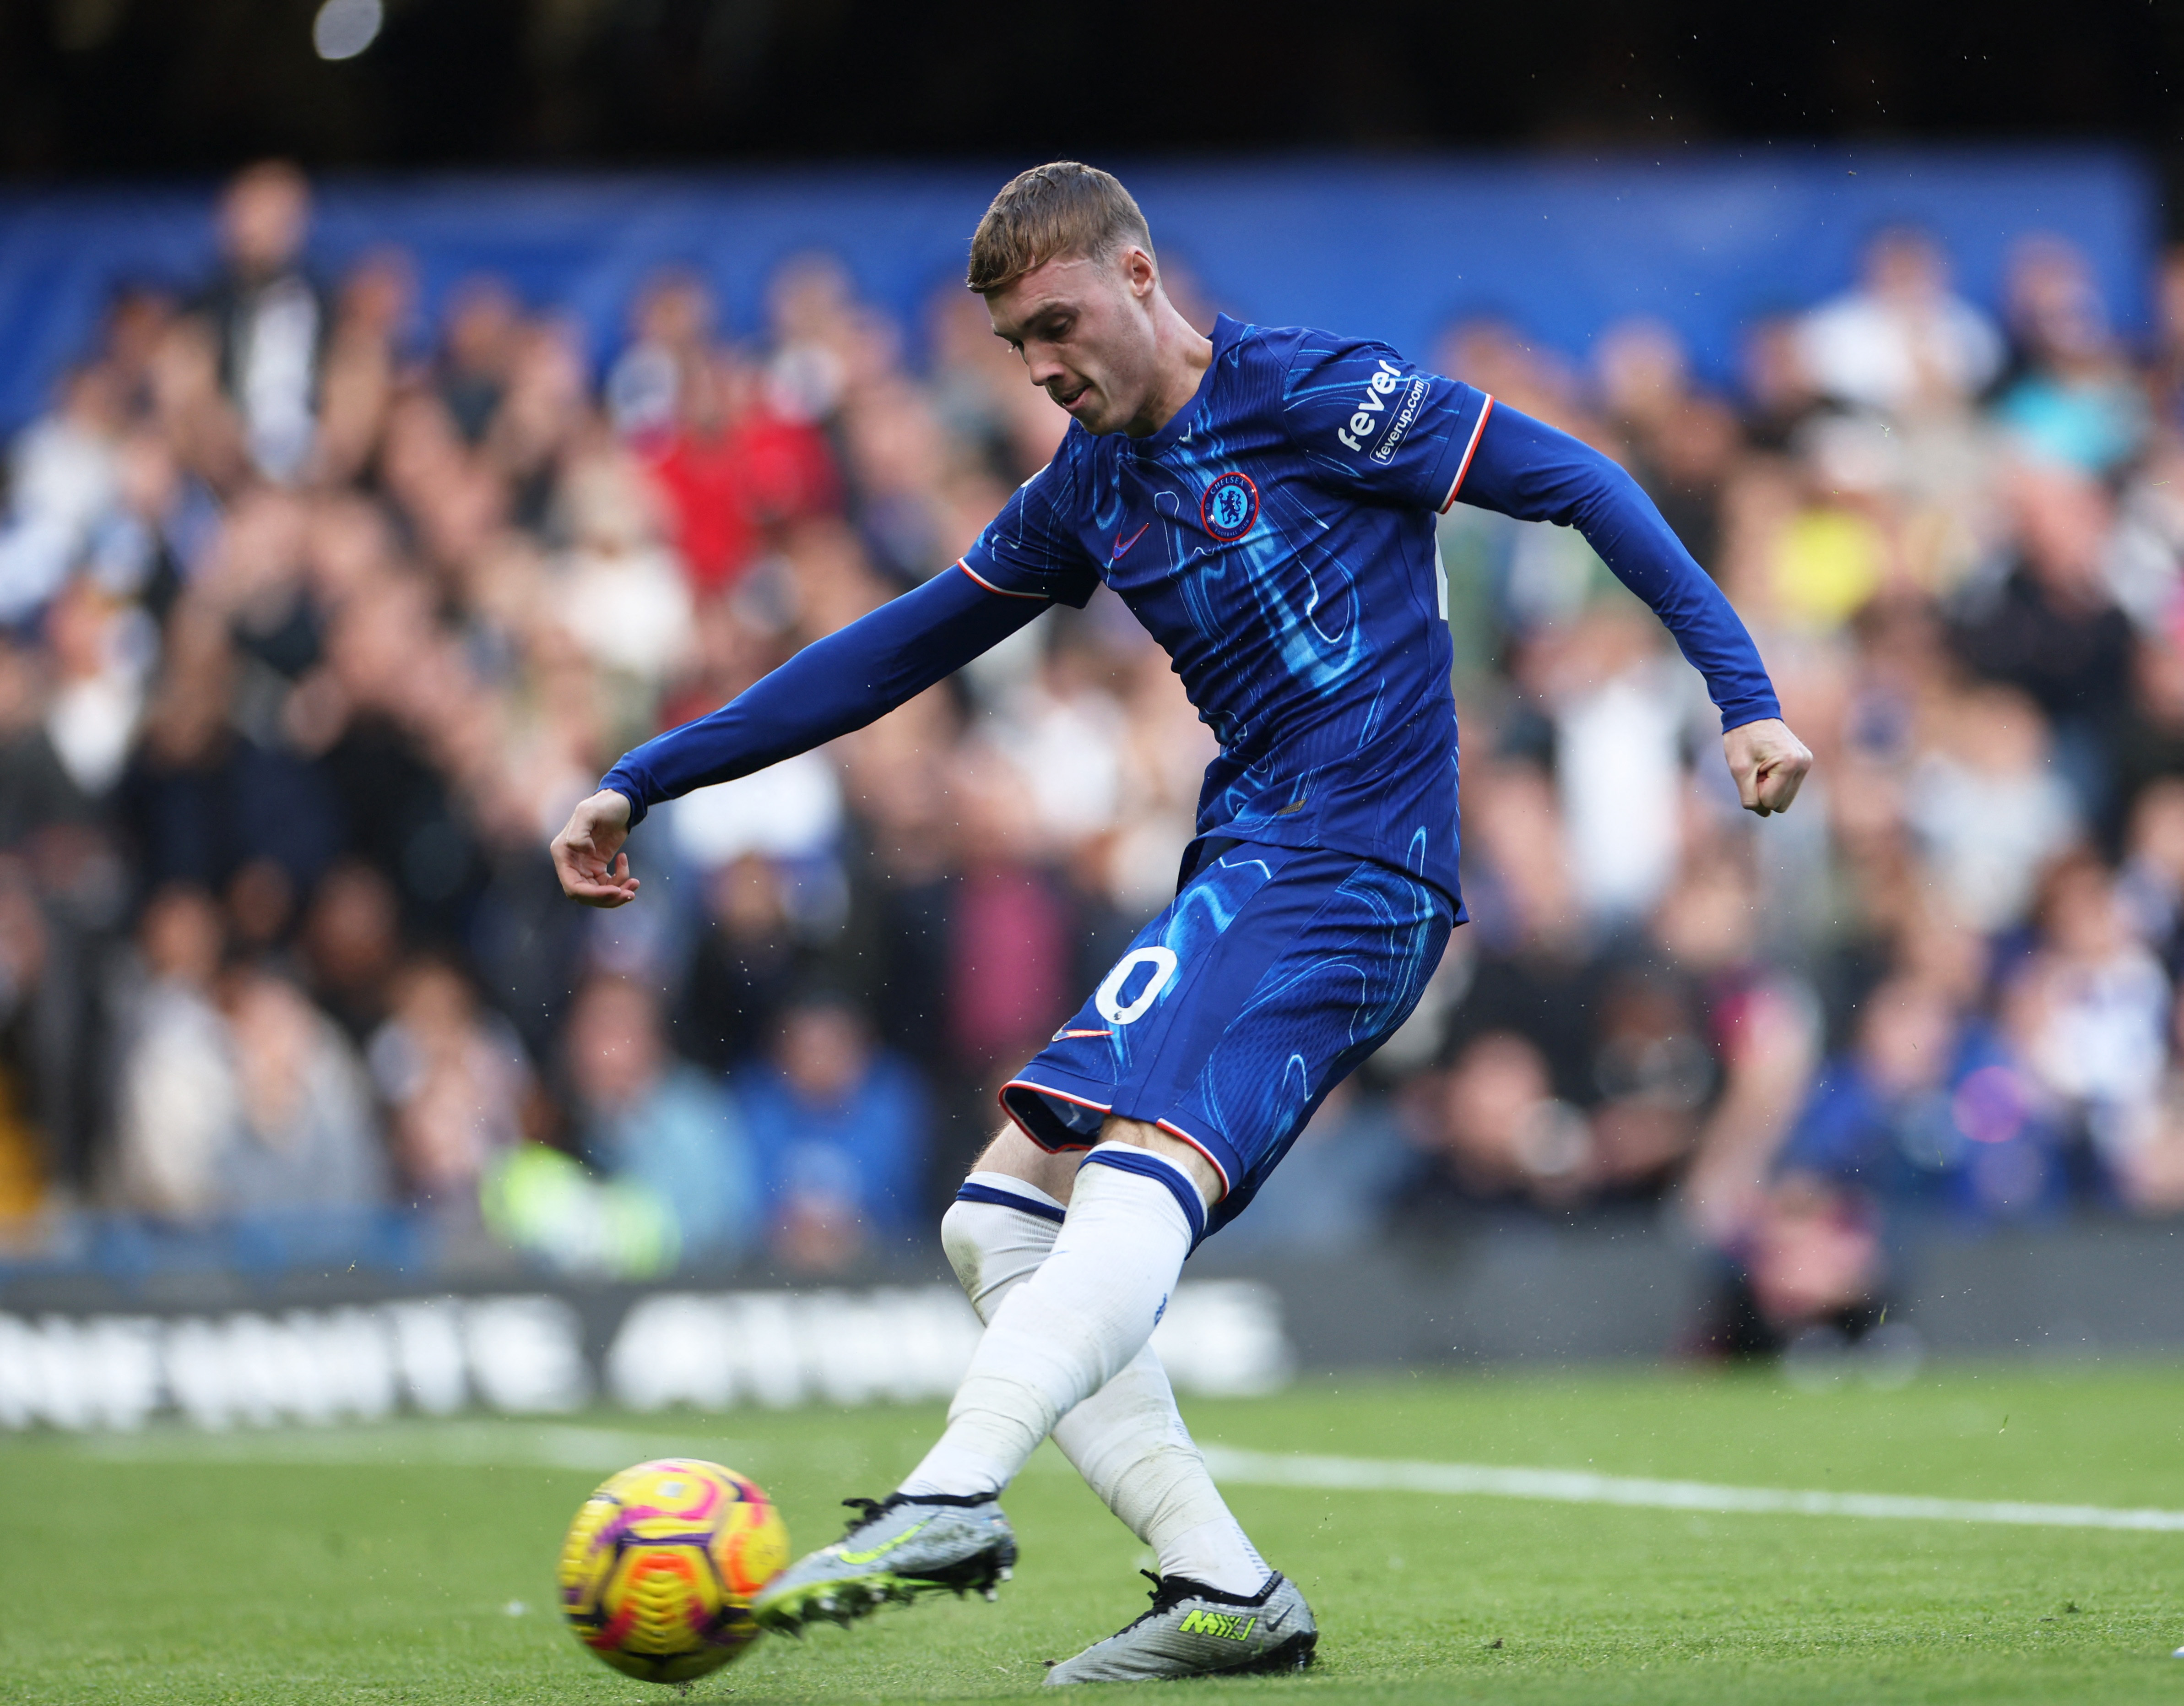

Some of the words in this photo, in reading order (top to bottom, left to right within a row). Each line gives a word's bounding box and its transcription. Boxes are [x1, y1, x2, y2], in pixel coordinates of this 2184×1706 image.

[1338, 359, 1401, 452] fever
[1376, 380, 1424, 461] feverup.com
[1210, 476, 1244, 494] CHELSEA
[1215, 528, 1238, 537] FOOTBALL
[1239, 520, 1250, 531] CLUB
